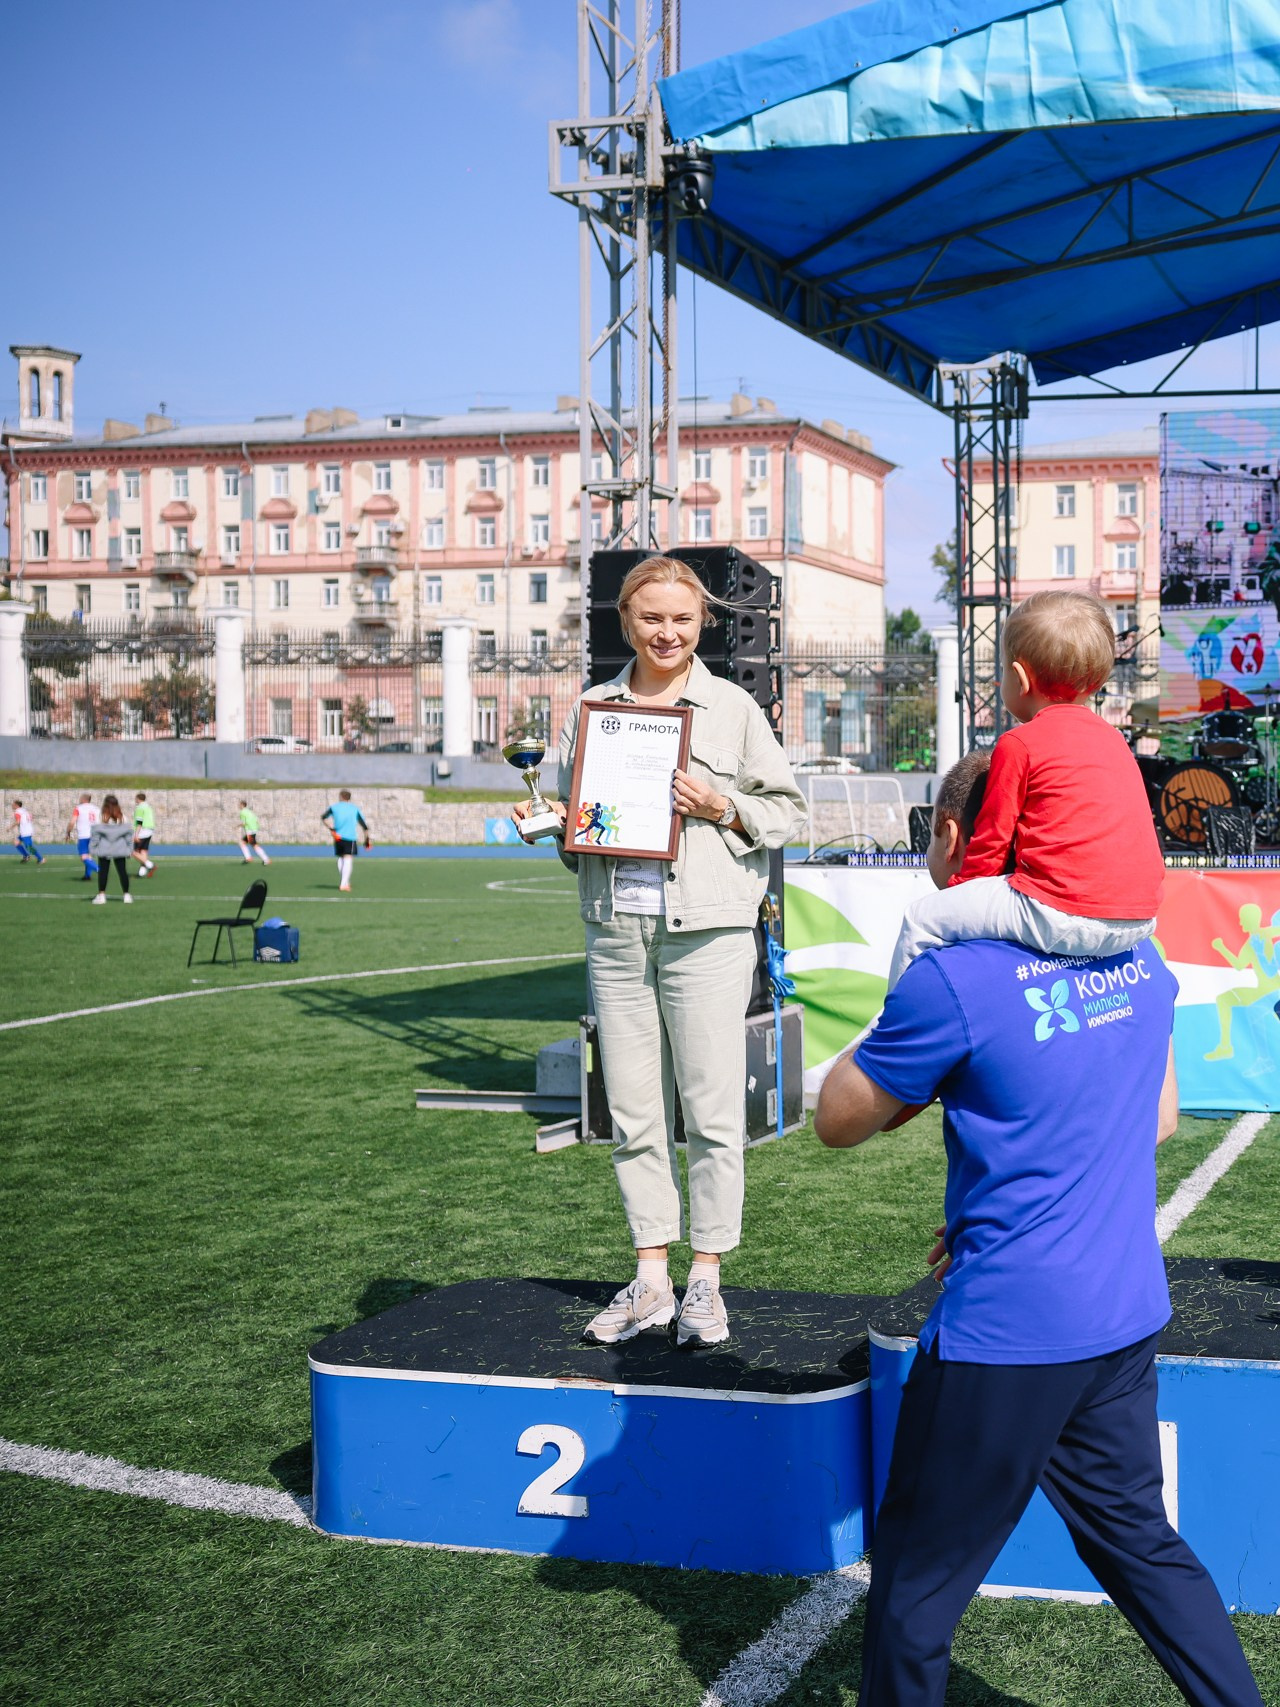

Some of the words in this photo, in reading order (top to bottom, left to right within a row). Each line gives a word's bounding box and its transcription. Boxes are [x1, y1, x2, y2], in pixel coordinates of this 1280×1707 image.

[629, 722, 680, 735] ГРАМОТА
[1074, 959, 1151, 999] КОМОС
[1083, 992, 1130, 1016] МИЛКОМ
[1087, 1006, 1133, 1029] ИЖМОЛОКО
[517, 1424, 588, 1517] 2
